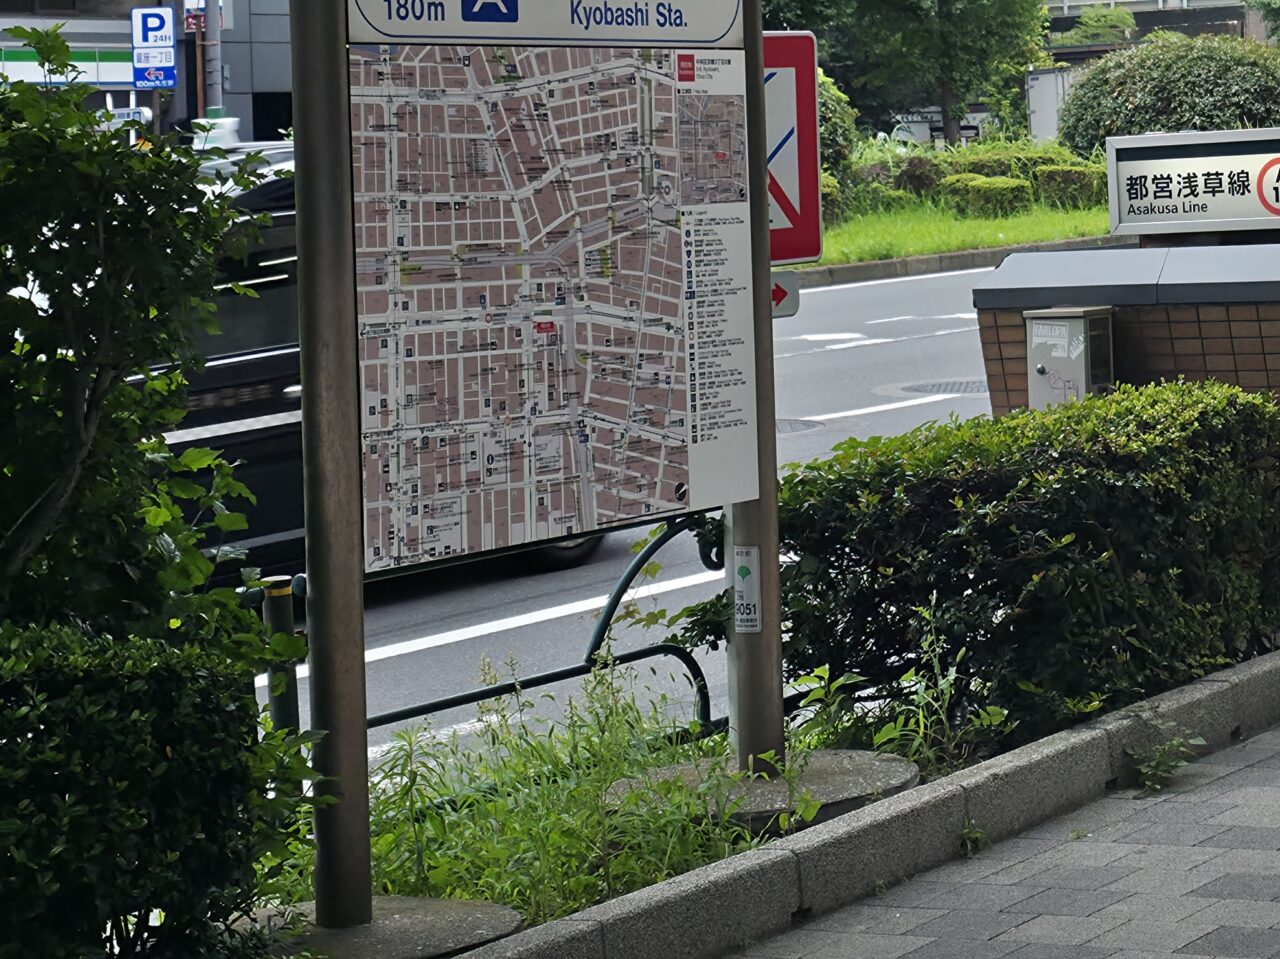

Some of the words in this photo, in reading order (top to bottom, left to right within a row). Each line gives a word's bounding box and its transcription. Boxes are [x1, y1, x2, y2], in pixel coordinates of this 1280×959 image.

[141, 13, 166, 43] P
[570, 0, 649, 31] Kyobashi
[655, 2, 689, 28] Sta.
[1126, 169, 1252, 202] 都営浅草線
[1127, 200, 1179, 216] Asakusa
[1182, 200, 1208, 213] Line
